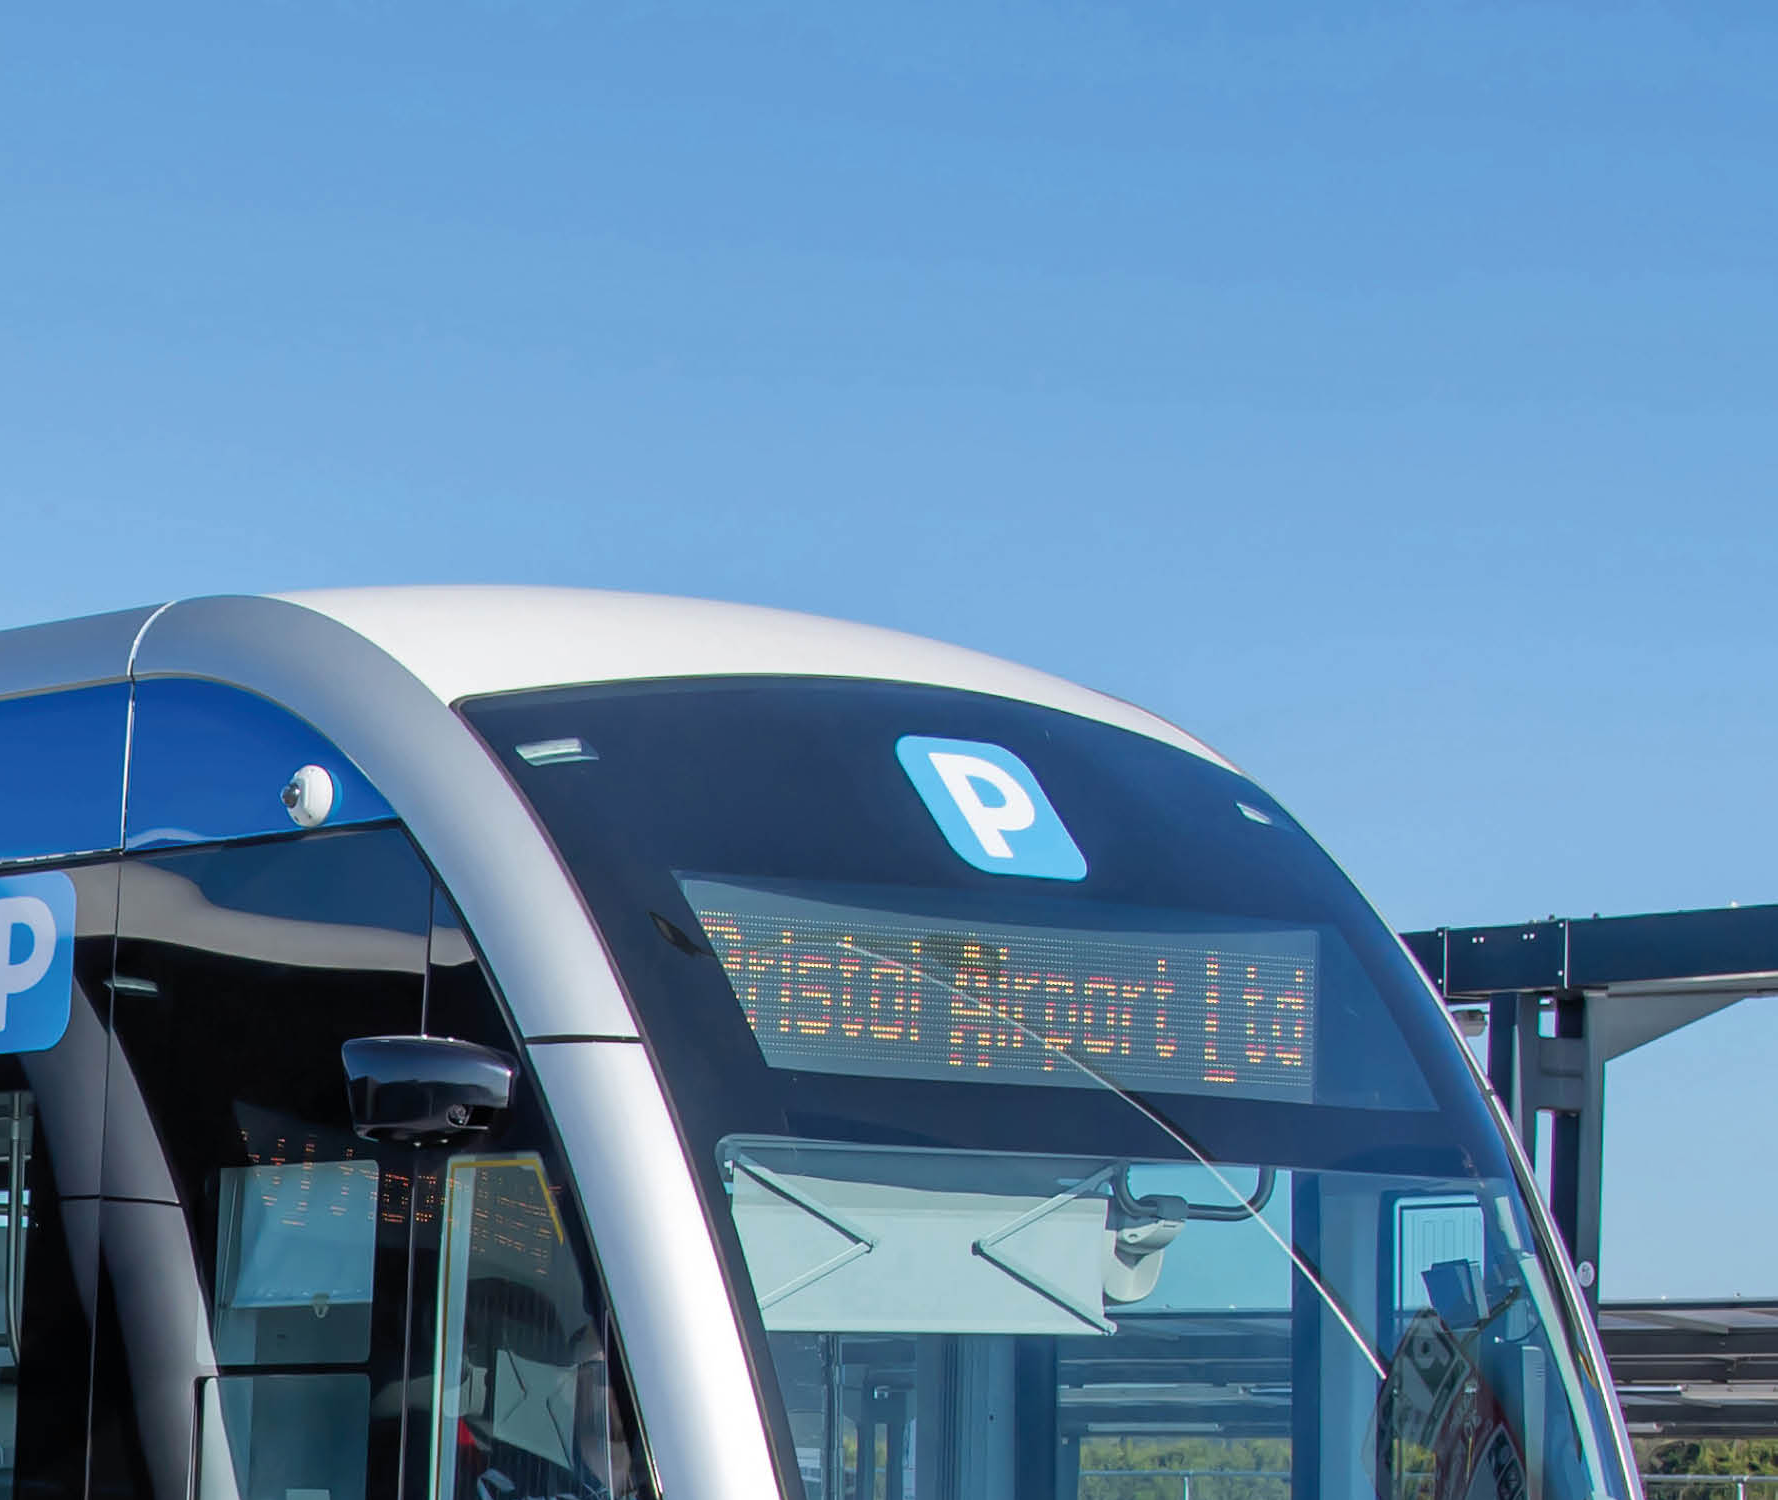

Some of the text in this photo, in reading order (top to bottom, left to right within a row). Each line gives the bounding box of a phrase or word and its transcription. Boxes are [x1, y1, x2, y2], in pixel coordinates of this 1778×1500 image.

[929, 753, 1035, 858] P
[949, 943, 1178, 1072] Airport
[1203, 950, 1307, 1083] Ltd
